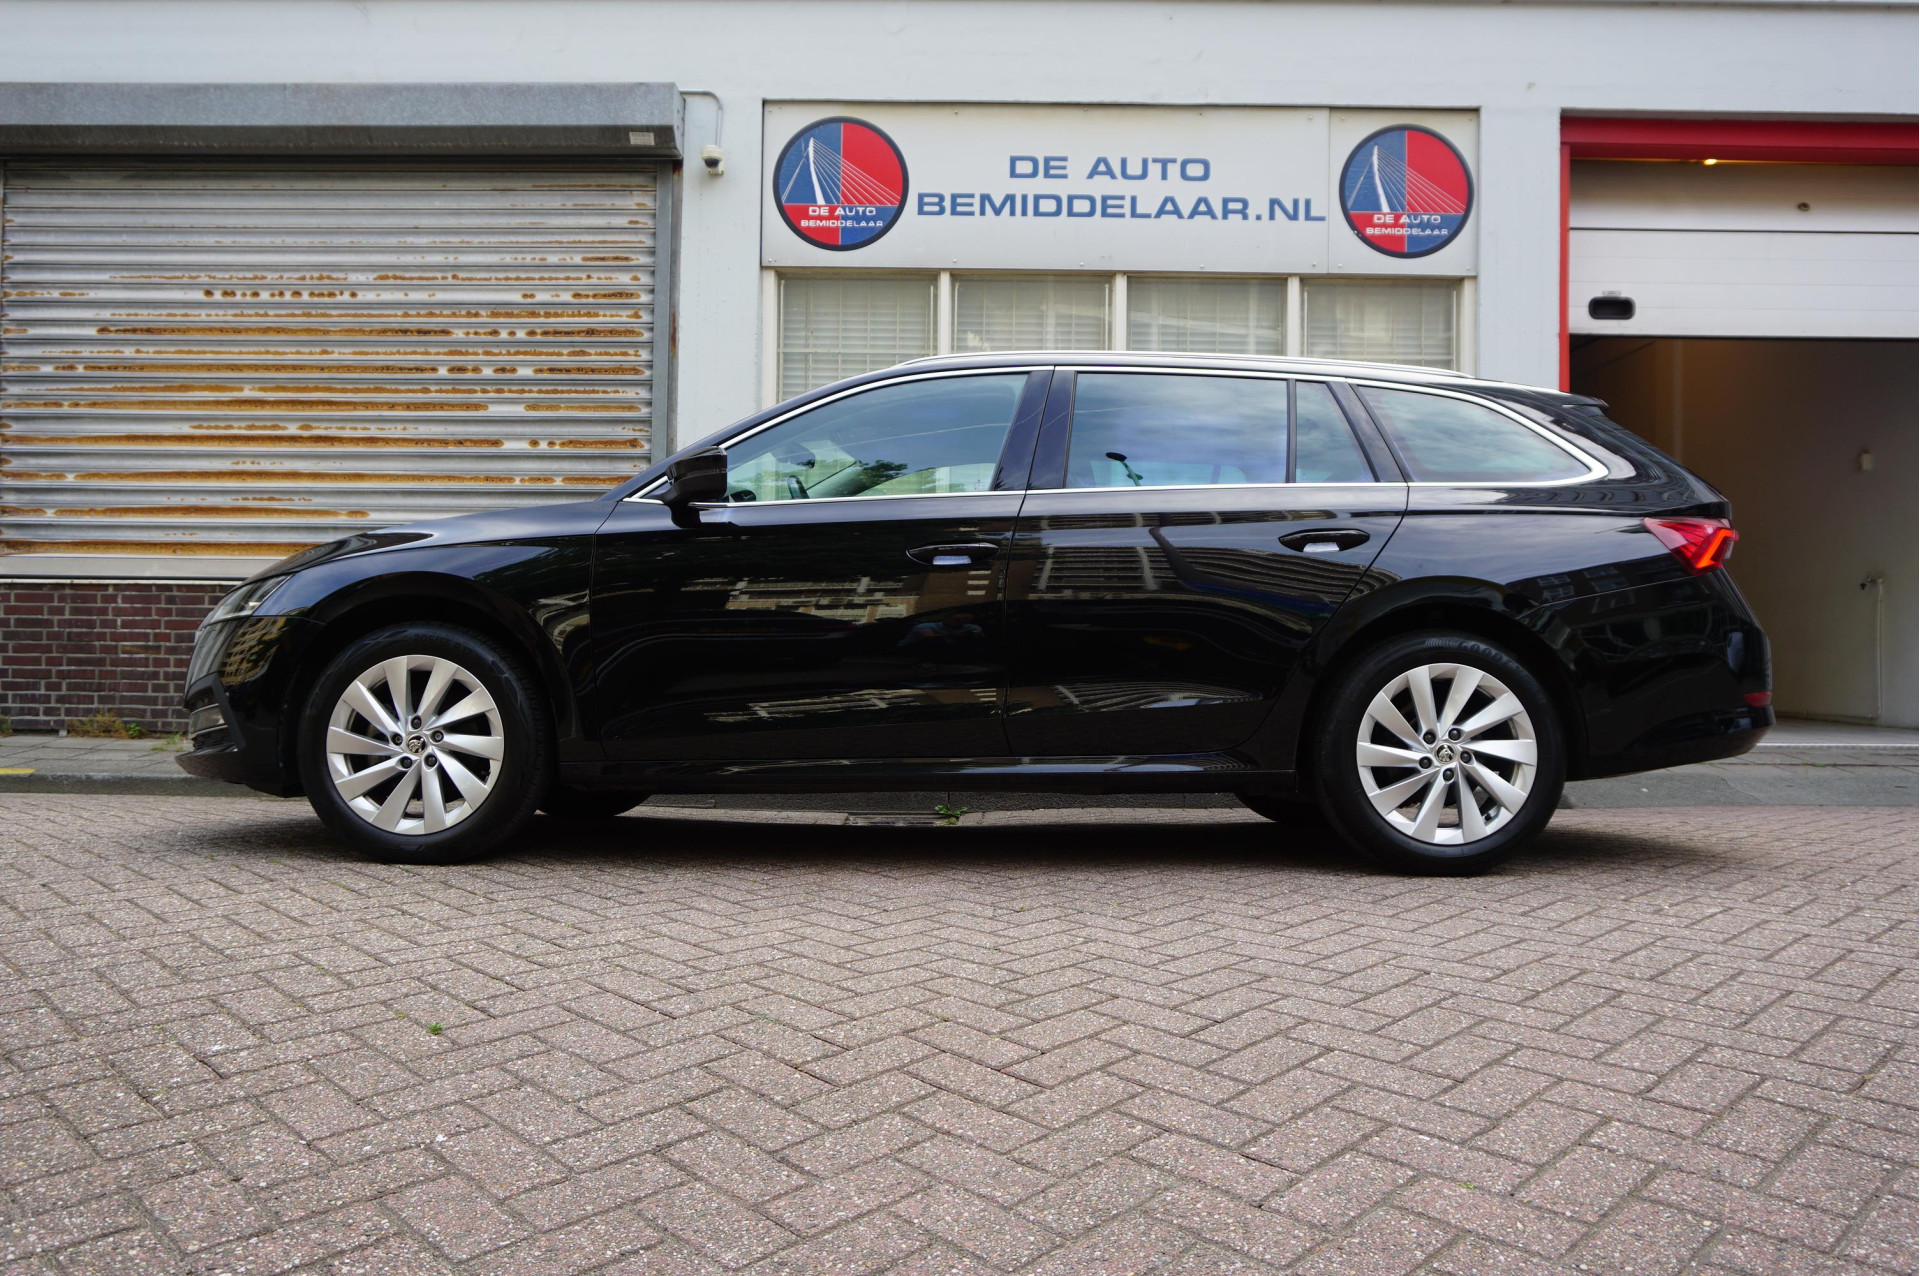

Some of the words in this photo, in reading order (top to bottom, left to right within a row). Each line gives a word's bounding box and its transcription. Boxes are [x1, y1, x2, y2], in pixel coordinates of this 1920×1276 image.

[1009, 155, 1069, 179] DE
[1086, 156, 1211, 182] AUTO
[808, 206, 829, 216] DE
[834, 206, 876, 216] AUTO
[917, 192, 1326, 222] BEMIDDELAAR.NL
[800, 219, 884, 228] BEMIDDELAAR
[1374, 214, 1395, 224] DE
[1399, 214, 1441, 224] AUTO
[1366, 227, 1449, 236] BEMIDDELAAR
